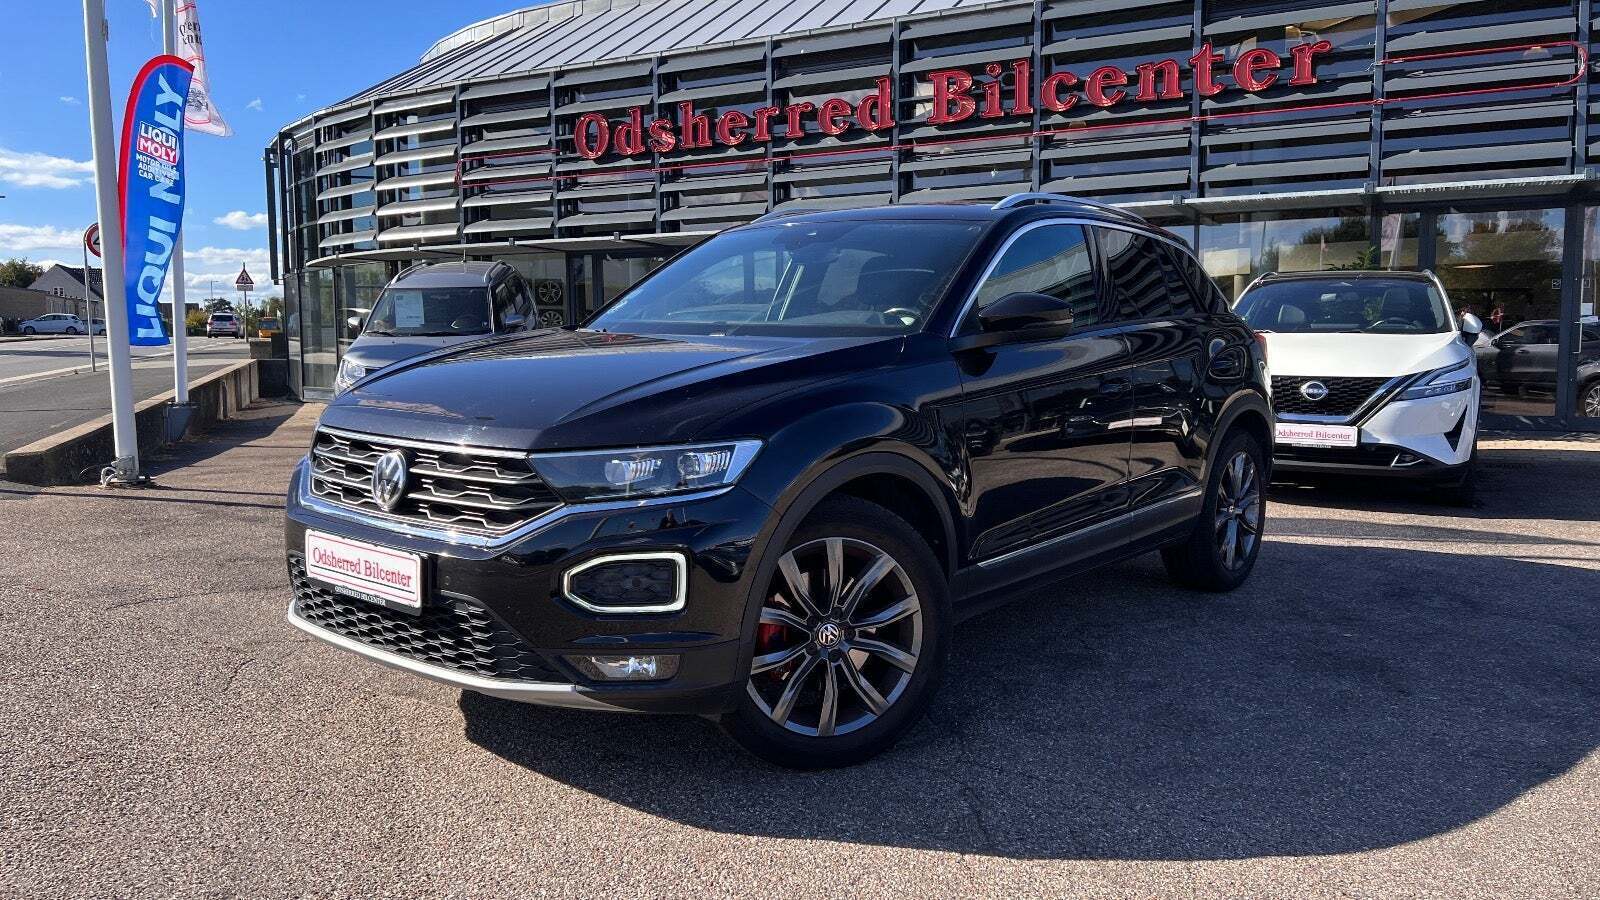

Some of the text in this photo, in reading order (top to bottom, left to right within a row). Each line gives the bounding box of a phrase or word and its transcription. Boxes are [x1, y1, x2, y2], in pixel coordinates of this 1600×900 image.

[574, 39, 1332, 160] Odsherred Bilcenter
[139, 137, 176, 162] MOLY
[140, 123, 177, 150] LIQUI
[136, 153, 161, 168] MOTOR
[139, 170, 155, 181] CAR
[137, 73, 184, 338] LIQUI MLY
[1315, 431, 1352, 440] Bilcenter
[313, 547, 412, 587] Odsherred Bilcenter
